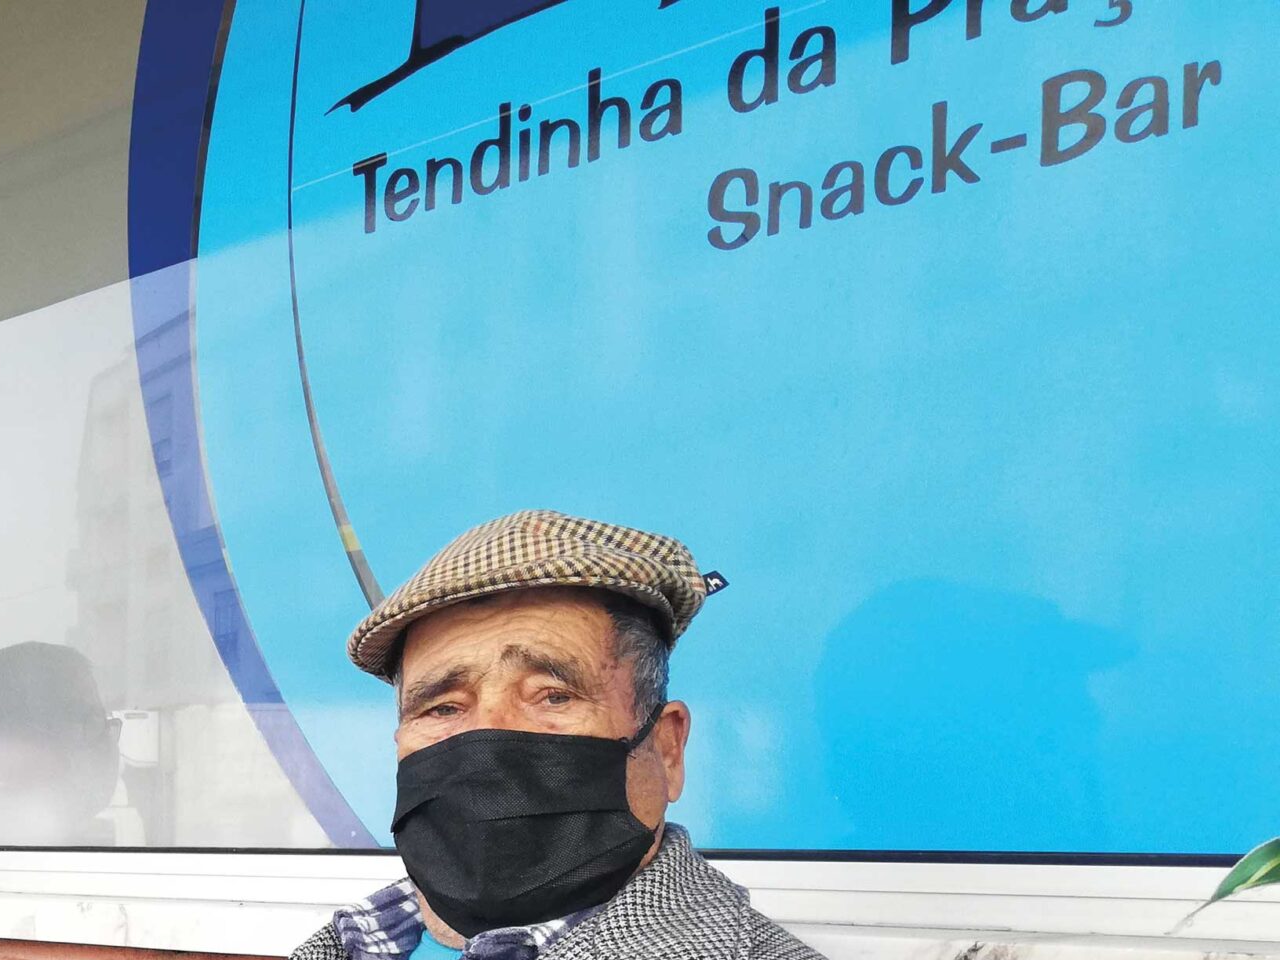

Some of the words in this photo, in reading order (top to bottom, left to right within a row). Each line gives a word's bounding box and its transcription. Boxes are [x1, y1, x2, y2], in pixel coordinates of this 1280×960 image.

[352, 67, 683, 234] Tendinha
[727, 6, 837, 113] da
[706, 58, 1222, 253] Snack-Bar
